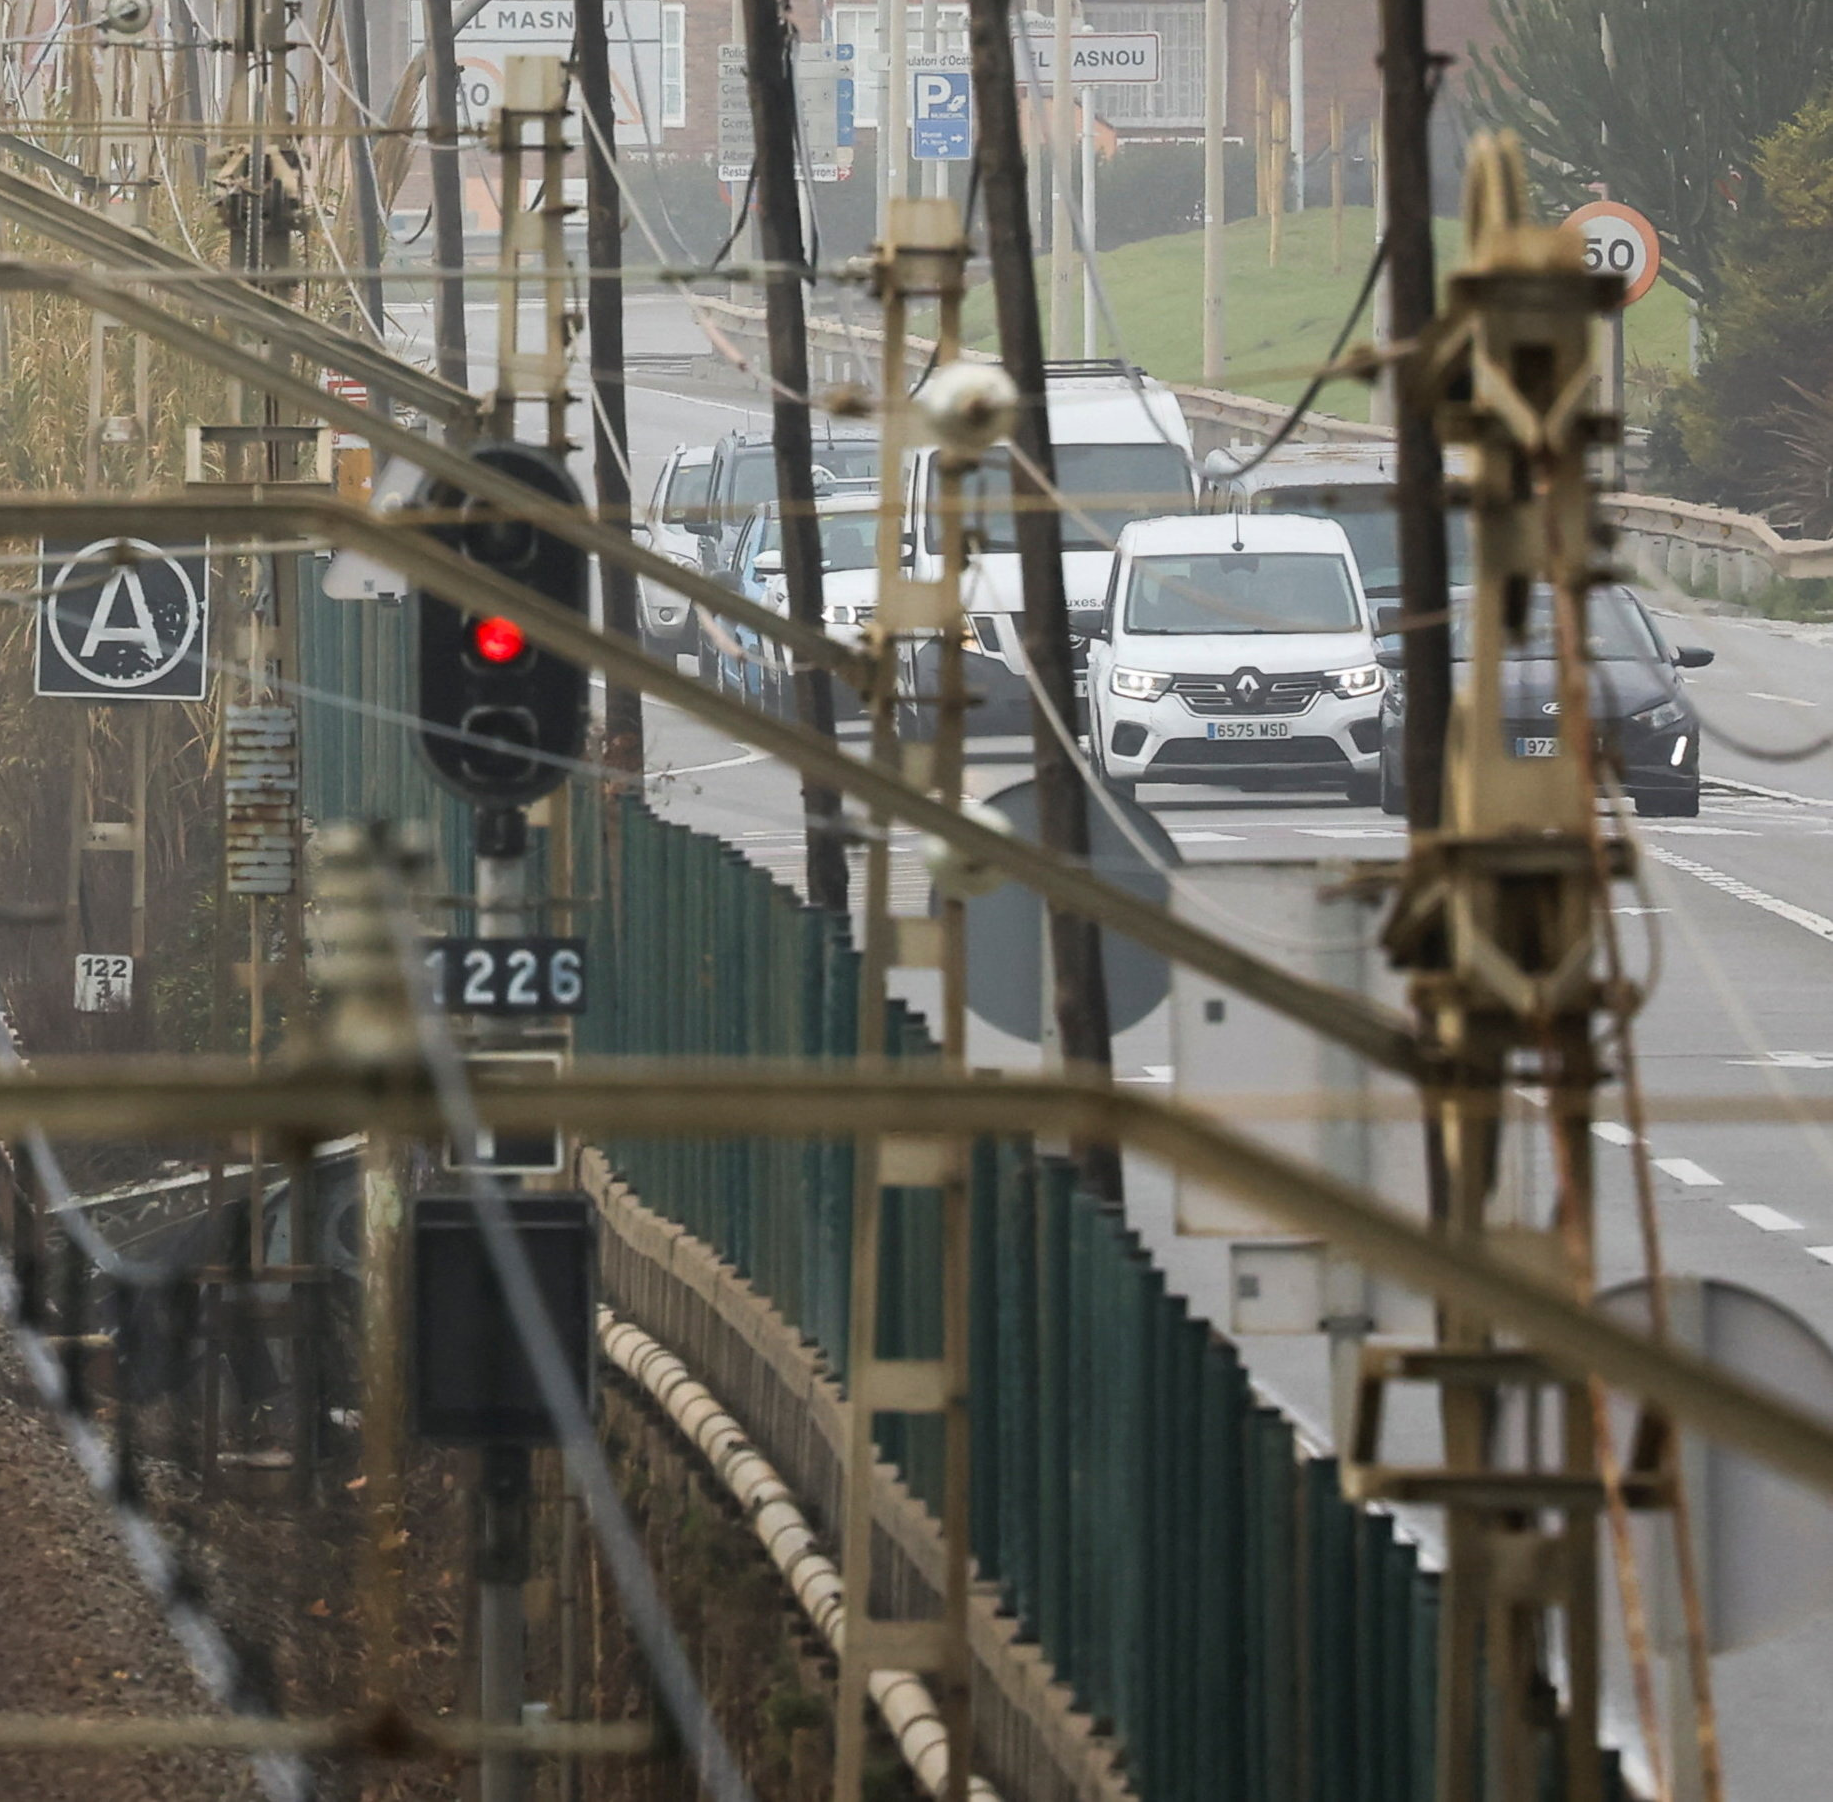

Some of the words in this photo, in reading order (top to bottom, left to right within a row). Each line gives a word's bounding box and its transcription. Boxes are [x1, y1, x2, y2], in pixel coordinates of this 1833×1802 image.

[1071, 51, 1146, 67] ASNOU
[917, 75, 951, 119] P
[1582, 238, 1634, 271] 50
[78, 562, 163, 660] A
[1217, 724, 1254, 738] 6575
[1260, 723, 1288, 737] MSD
[1528, 740, 1557, 754] 972
[81, 958, 128, 978] 122
[429, 949, 582, 1005] 1226
